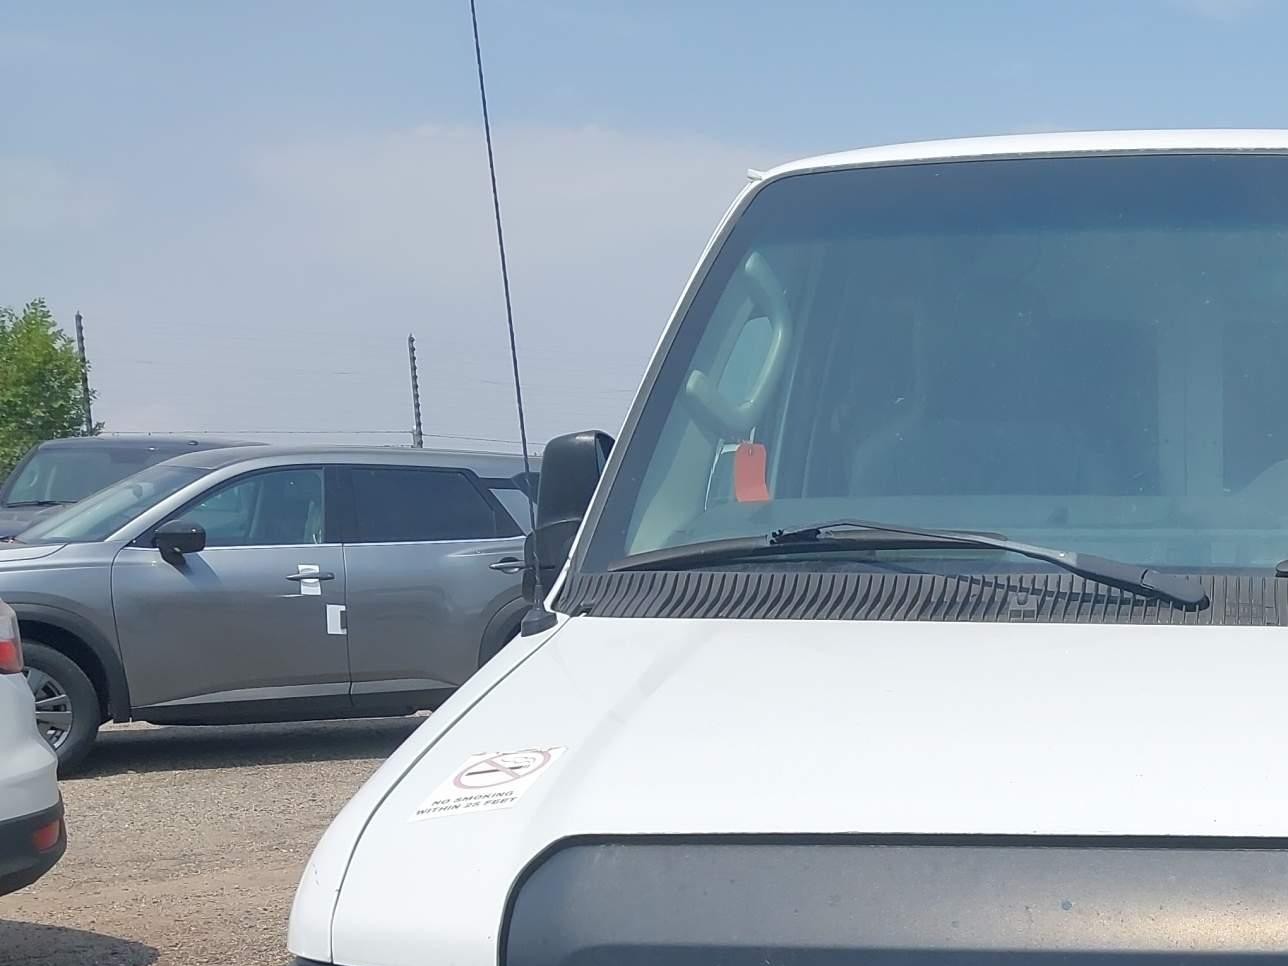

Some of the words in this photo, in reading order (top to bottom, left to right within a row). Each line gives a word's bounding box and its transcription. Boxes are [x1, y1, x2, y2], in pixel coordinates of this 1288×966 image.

[416, 803, 461, 815] WITHIN
[483, 796, 518, 806] FEET
[432, 798, 451, 806] NO
[454, 790, 515, 803] SMOKING
